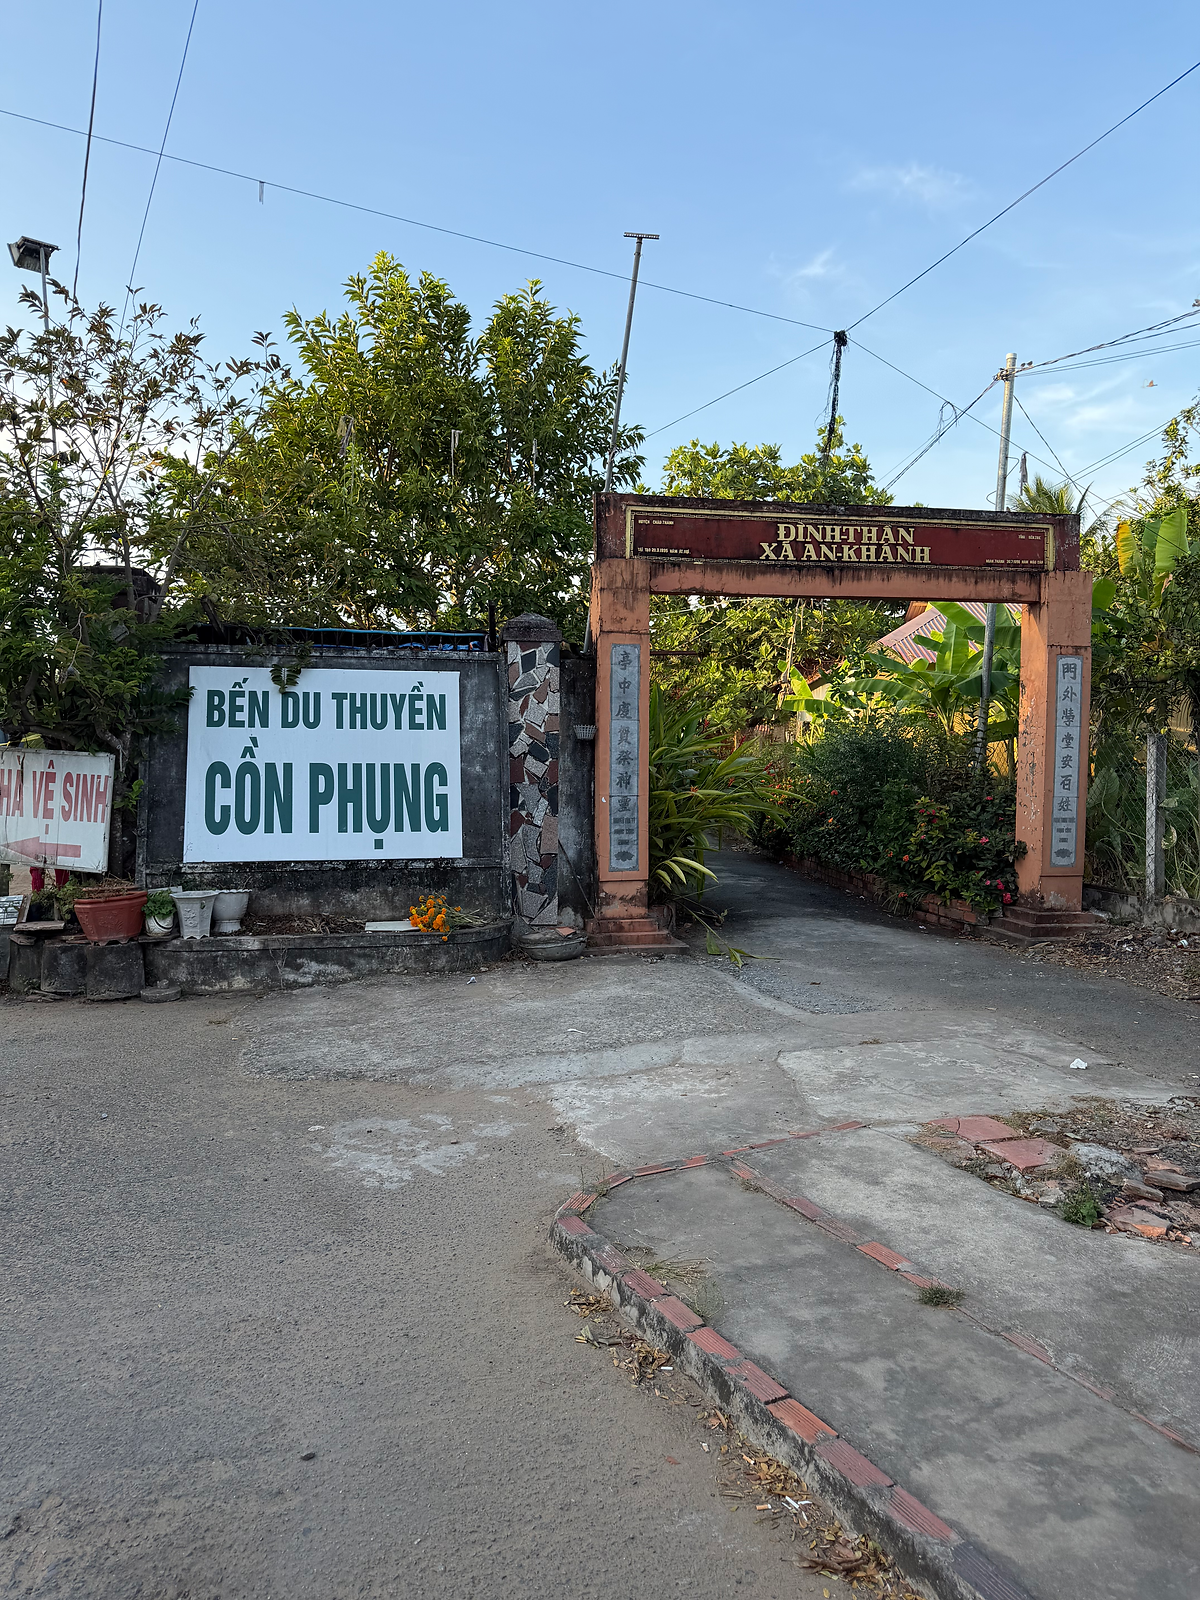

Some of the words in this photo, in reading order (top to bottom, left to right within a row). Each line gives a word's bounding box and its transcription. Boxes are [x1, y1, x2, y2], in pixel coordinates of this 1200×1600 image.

[759, 540, 796, 561] XÃ
[801, 543, 932, 564] AN-KHÁNH
[206, 677, 270, 729] BẾN
[281, 691, 322, 729] DU
[331, 681, 447, 731] THUYỀN
[32, 759, 57, 835] VỆ
[60, 771, 109, 823] SINH
[204, 736, 293, 836] CỒN
[308, 761, 450, 850] PHỤNG
